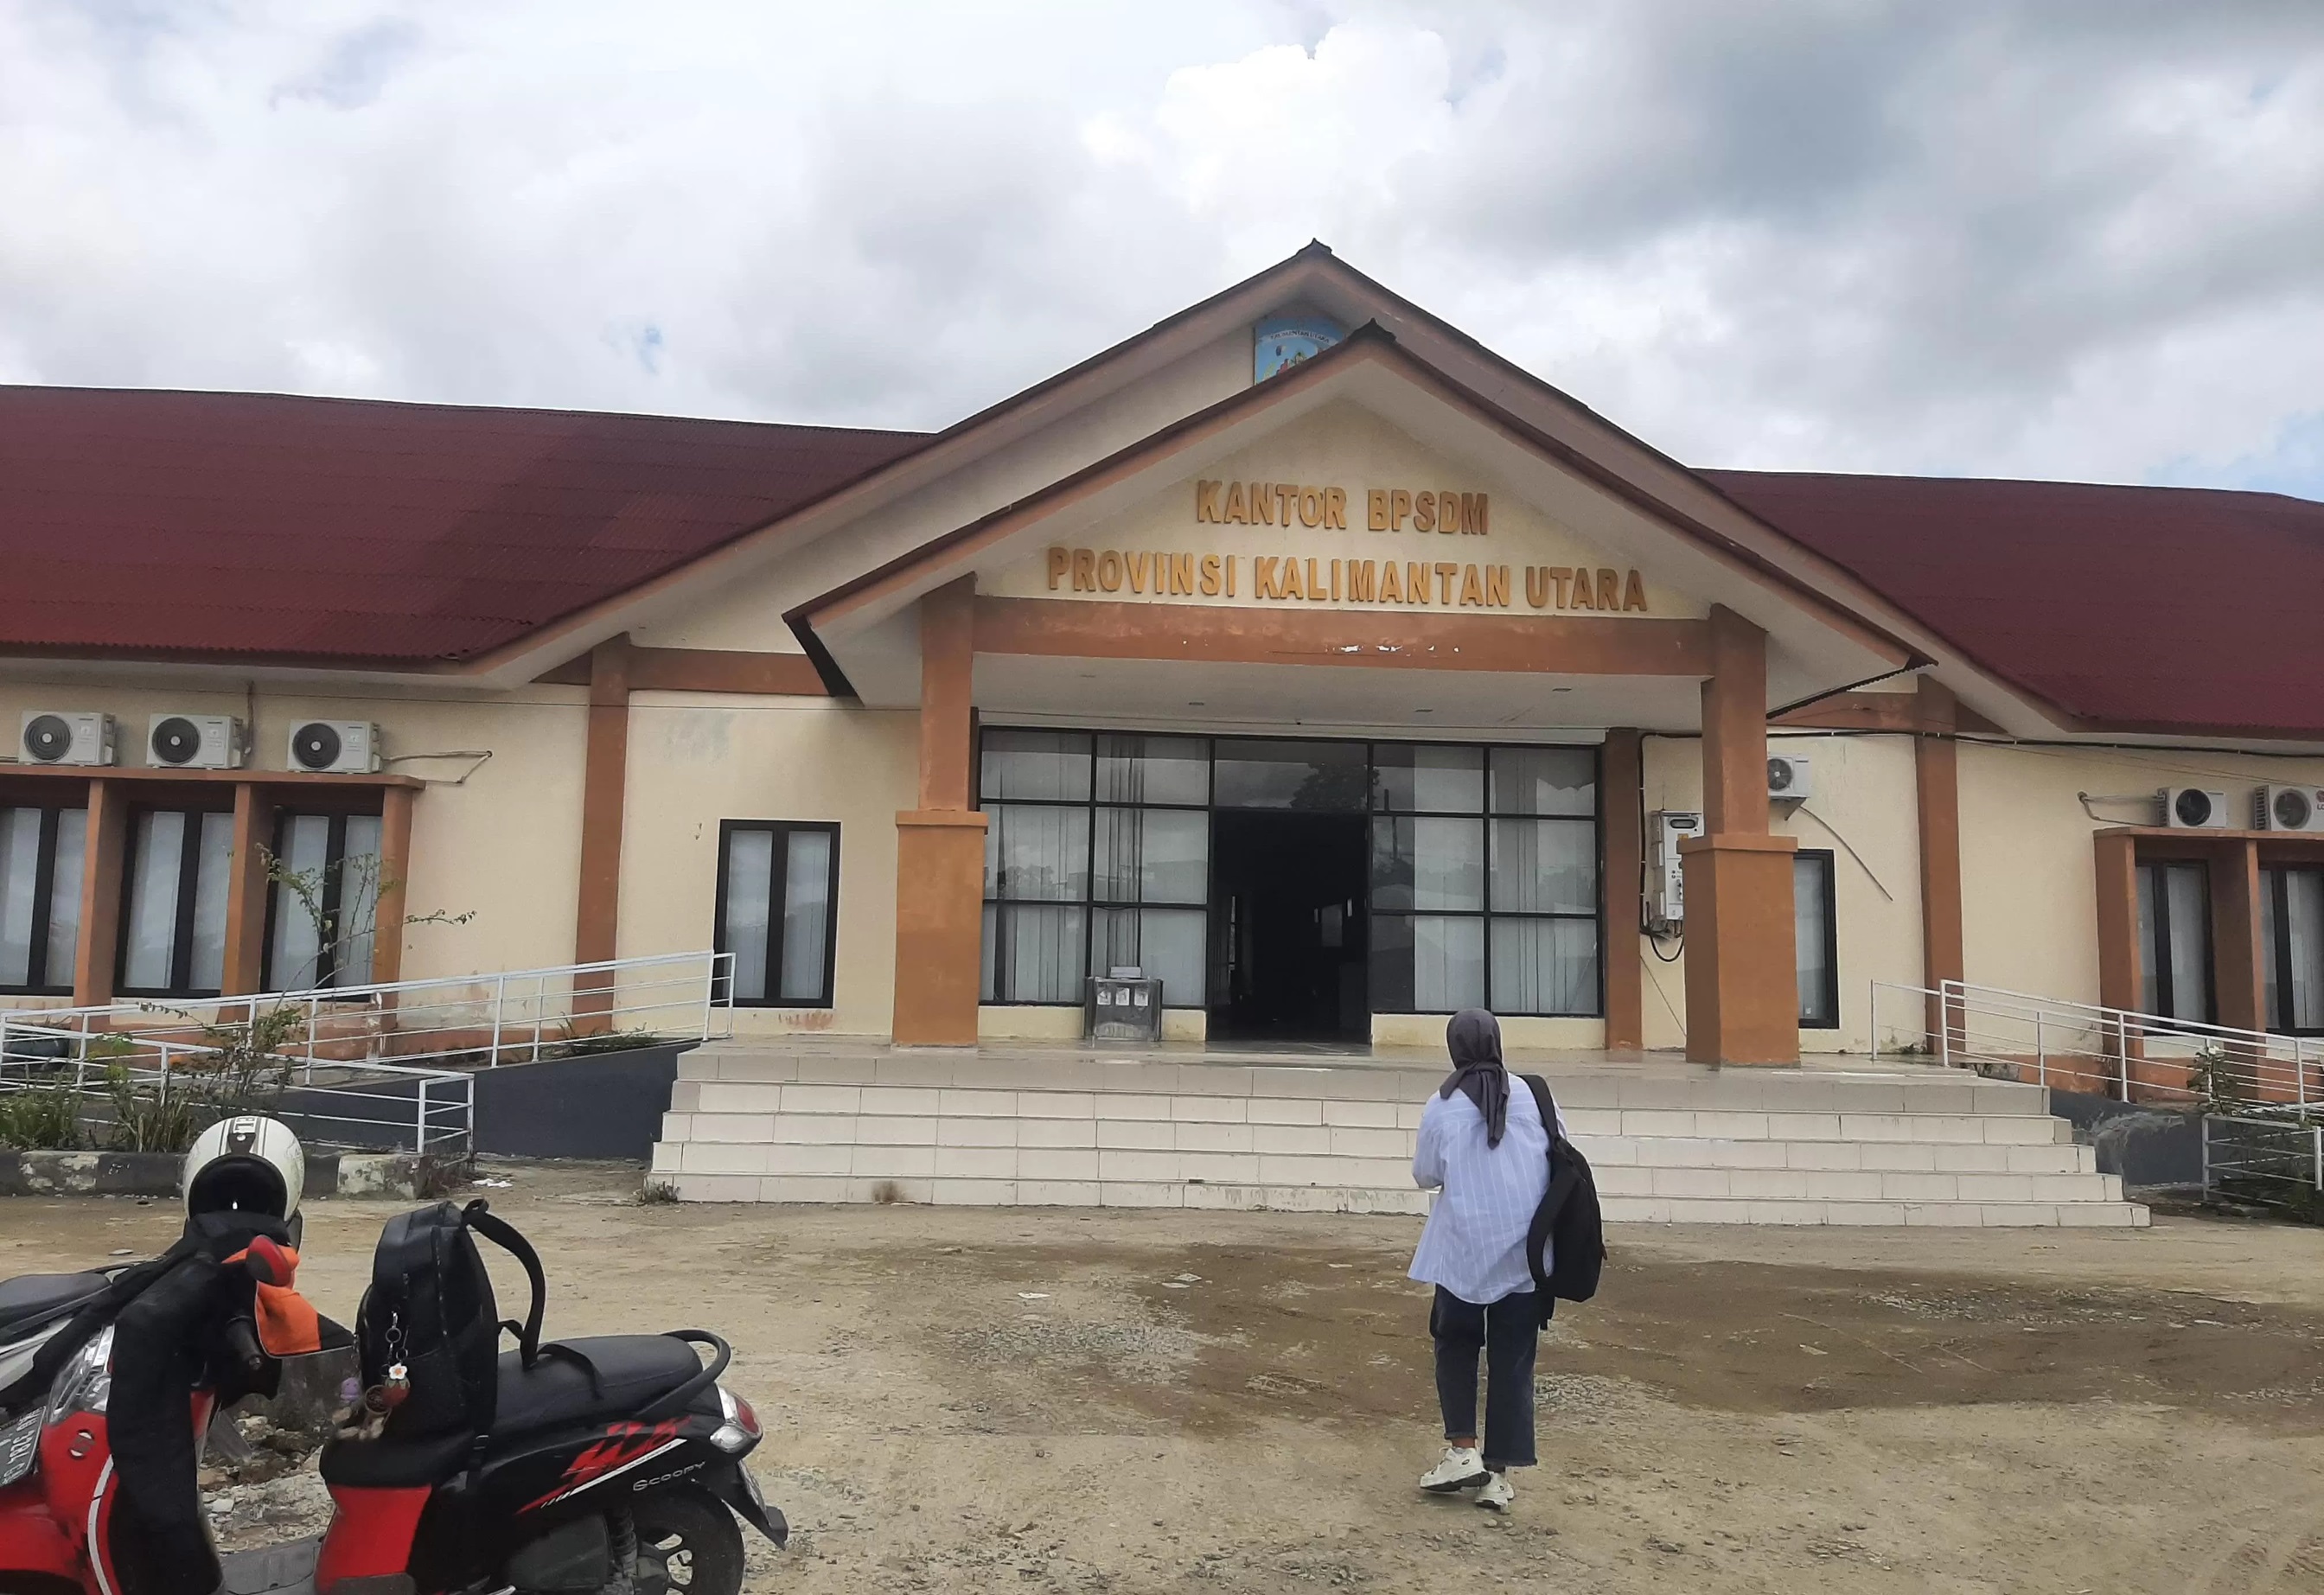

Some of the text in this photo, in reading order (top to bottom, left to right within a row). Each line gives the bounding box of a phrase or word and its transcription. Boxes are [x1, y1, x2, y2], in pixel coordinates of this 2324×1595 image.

[1197, 480, 1488, 536] KANTOR BPSDM
[1048, 546, 1648, 612] PROVINSI KALIMANTAN UTARA
